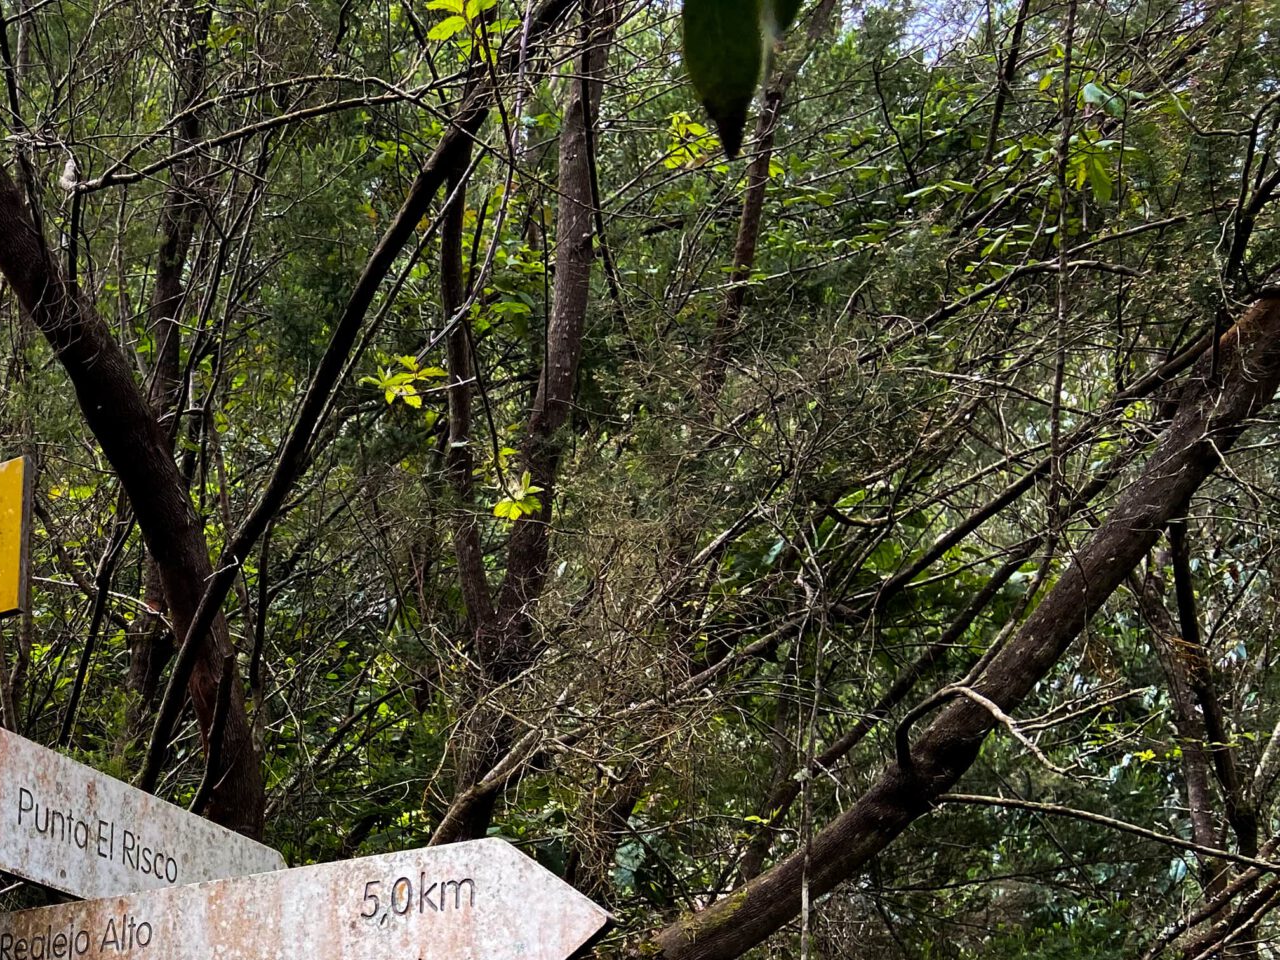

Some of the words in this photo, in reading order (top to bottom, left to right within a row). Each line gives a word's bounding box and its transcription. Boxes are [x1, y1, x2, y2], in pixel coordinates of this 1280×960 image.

[17, 787, 90, 849] Punta
[97, 819, 116, 860] El
[122, 829, 179, 884] Risco
[99, 914, 154, 953] Alto
